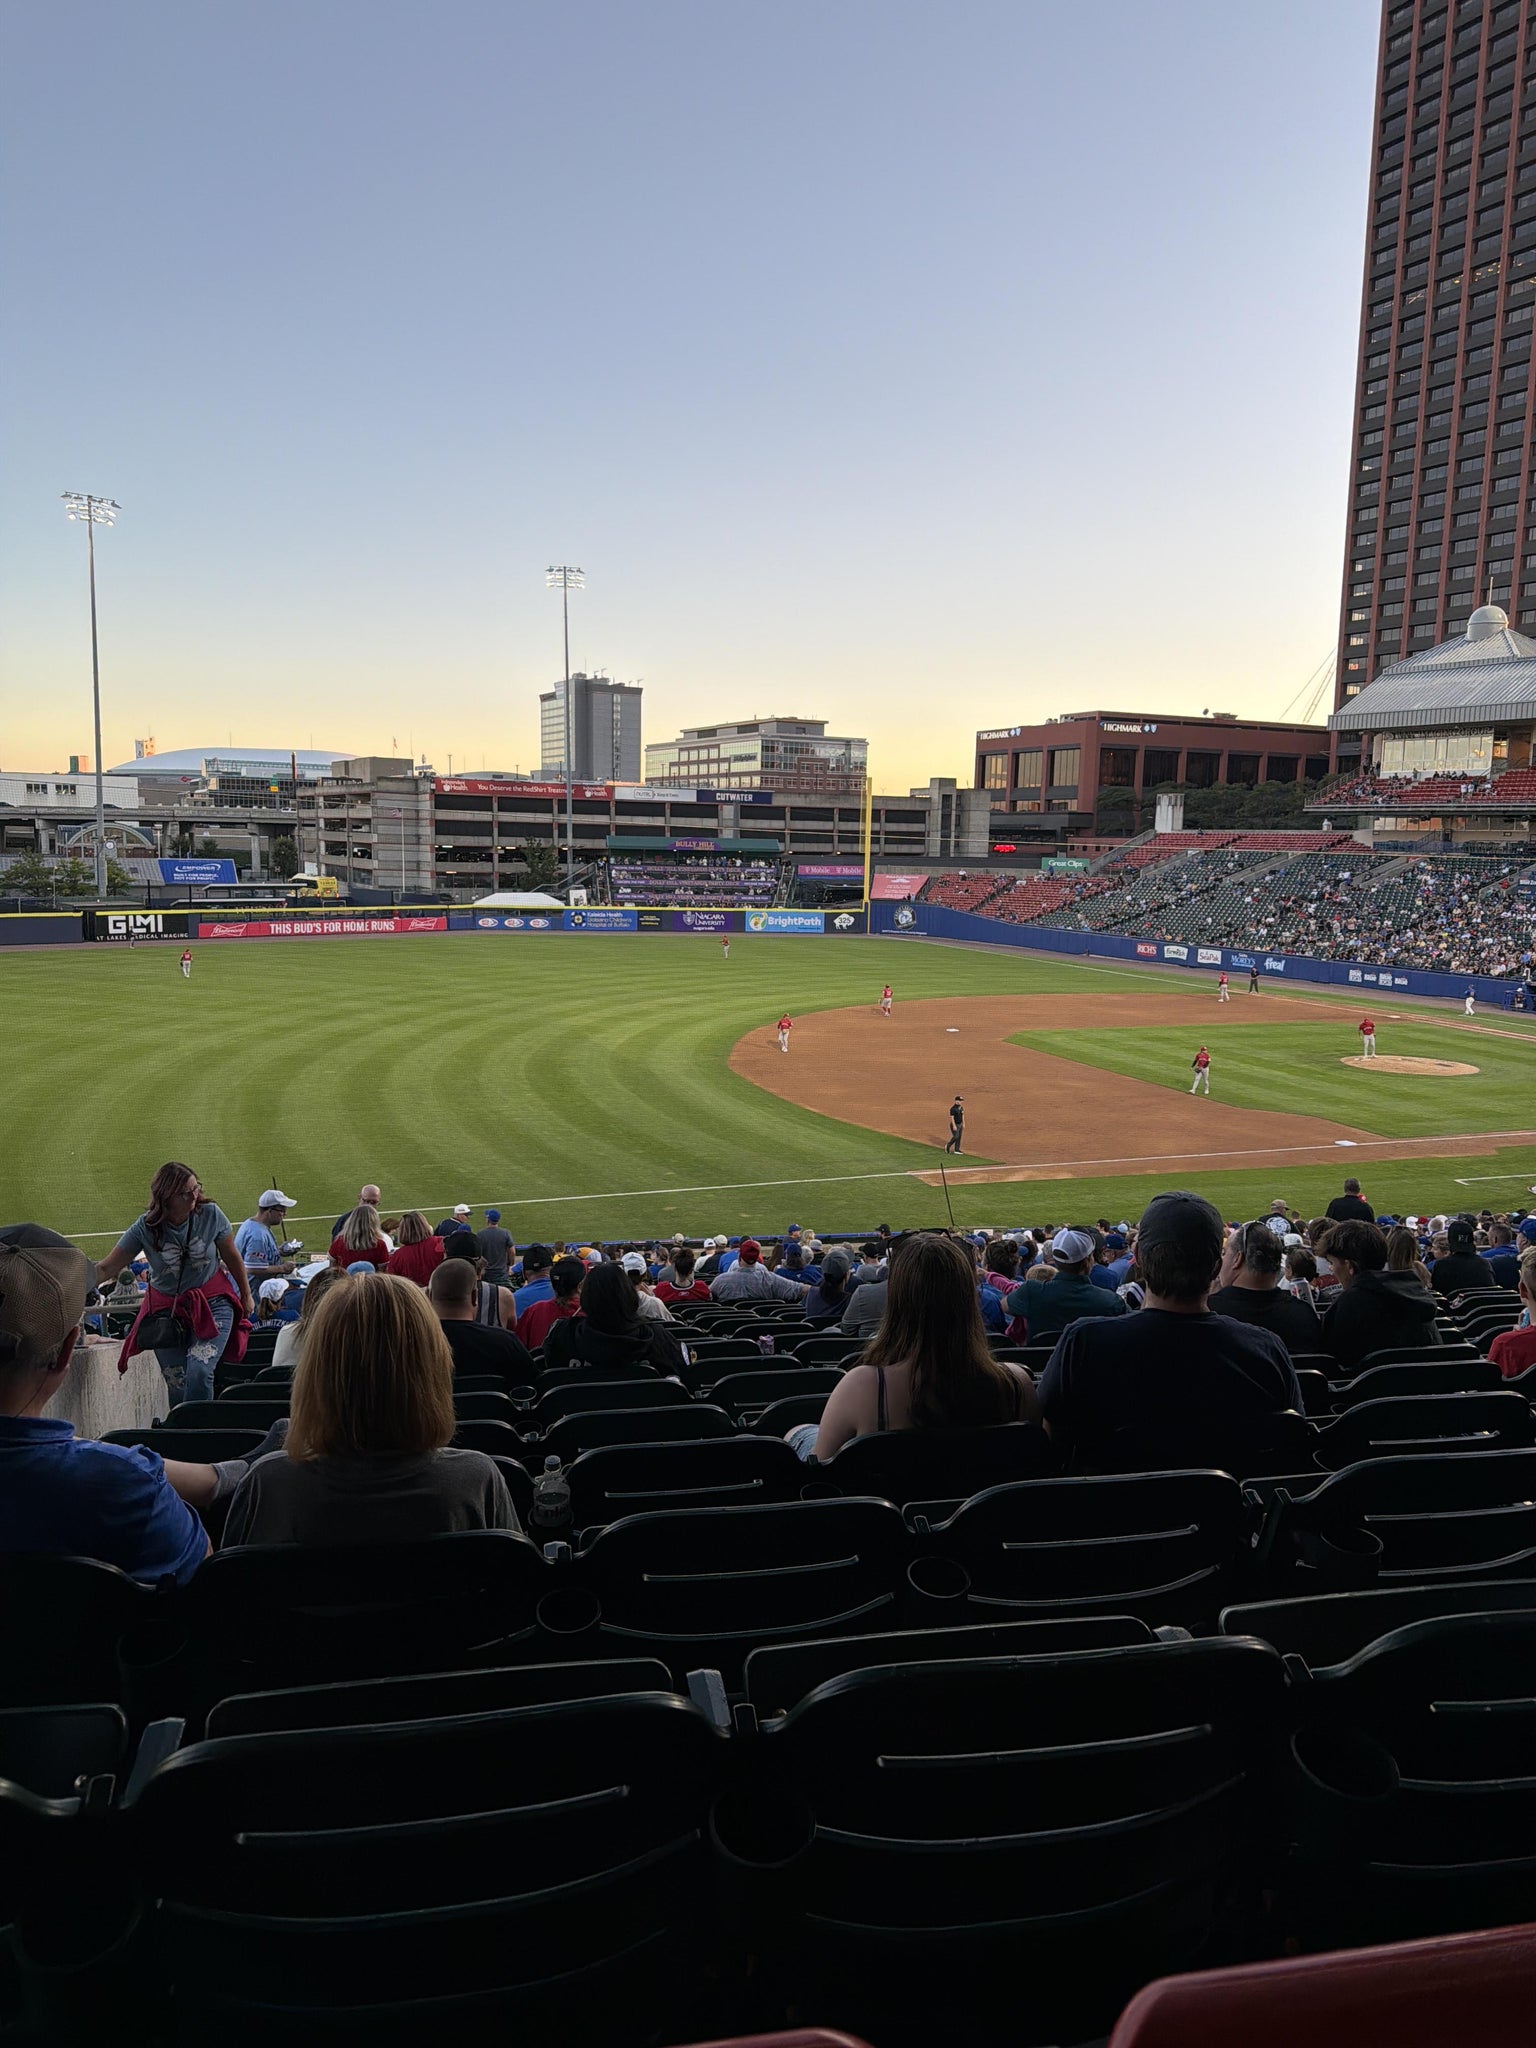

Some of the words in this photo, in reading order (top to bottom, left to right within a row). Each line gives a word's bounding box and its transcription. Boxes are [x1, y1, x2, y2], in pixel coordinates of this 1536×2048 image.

[1103, 723, 1142, 733] HIGHMARK
[980, 730, 1009, 740] HIGHMARK
[523, 785, 546, 793] RedShirt
[716, 792, 753, 802] CUTWATER
[1067, 860, 1083, 868] Clips
[811, 866, 831, 874] Mobile
[695, 912, 725, 920] NIAGARA
[768, 915, 822, 927] BrightPath
[269, 923, 292, 934] THIS
[293, 922, 322, 934] BUD'S
[323, 922, 341, 932] FOR
[343, 921, 369, 932] HOME
[371, 920, 395, 931] RUNS
[1137, 944, 1157, 955] RICH'S
[1199, 951, 1220, 962] SeaPak
